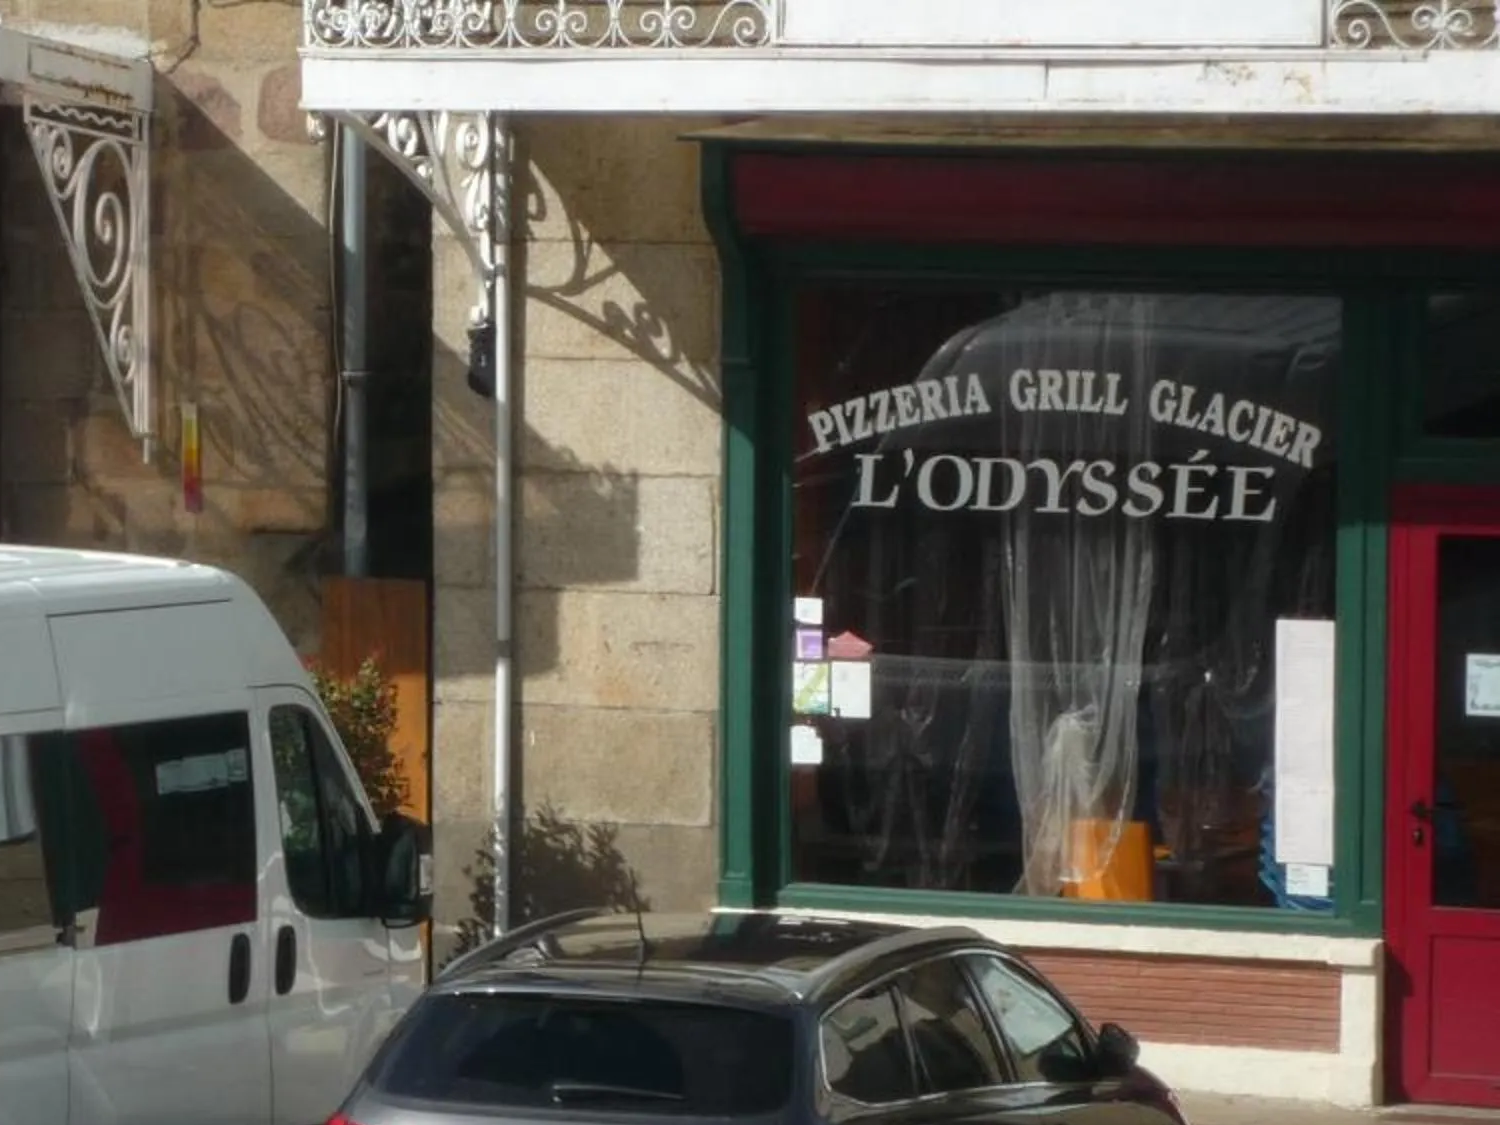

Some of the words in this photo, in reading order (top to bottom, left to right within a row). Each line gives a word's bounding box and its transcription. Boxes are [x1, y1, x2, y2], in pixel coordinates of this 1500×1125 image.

[808, 373, 991, 453] PIZZERIA
[1009, 369, 1128, 416] GRILL
[1149, 379, 1322, 469] GLACIER
[851, 449, 1277, 522] L'ODYSSÉE
